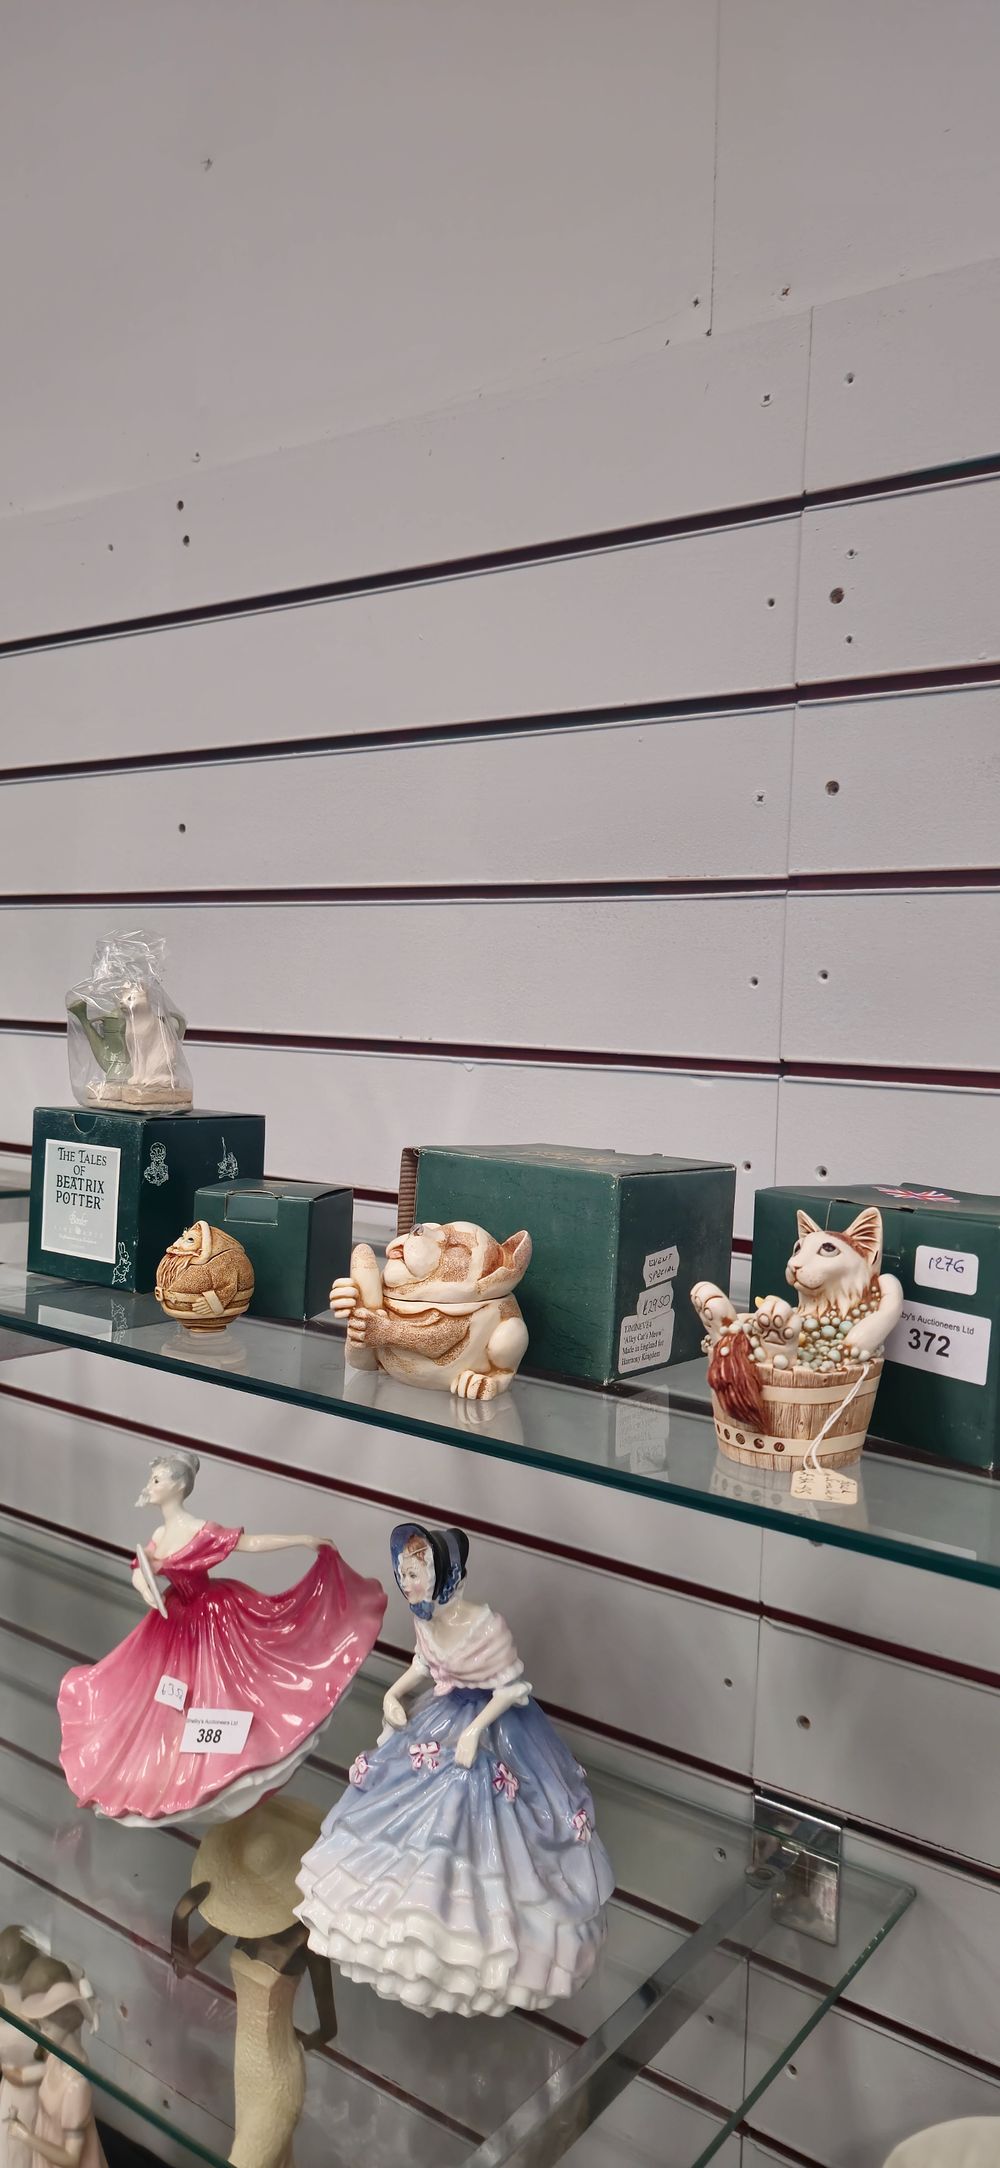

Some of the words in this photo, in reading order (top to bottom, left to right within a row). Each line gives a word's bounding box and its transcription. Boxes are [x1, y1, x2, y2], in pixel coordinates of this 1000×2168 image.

[57, 1147, 76, 1162] THE
[79, 1149, 107, 1167] TALES
[73, 1165, 86, 1176] OF
[56, 1174, 104, 1194] BEATRIX
[648, 1253, 673, 1267] EVENT
[928, 1256, 965, 1274] 1276
[648, 1265, 676, 1282] SPECIAL
[917, 1315, 961, 1332] Auctioneers
[962, 1325, 975, 1335] Ltd
[640, 1340, 658, 1352] England
[908, 1328, 951, 1358] 372
[196, 1728, 222, 1743] 388
